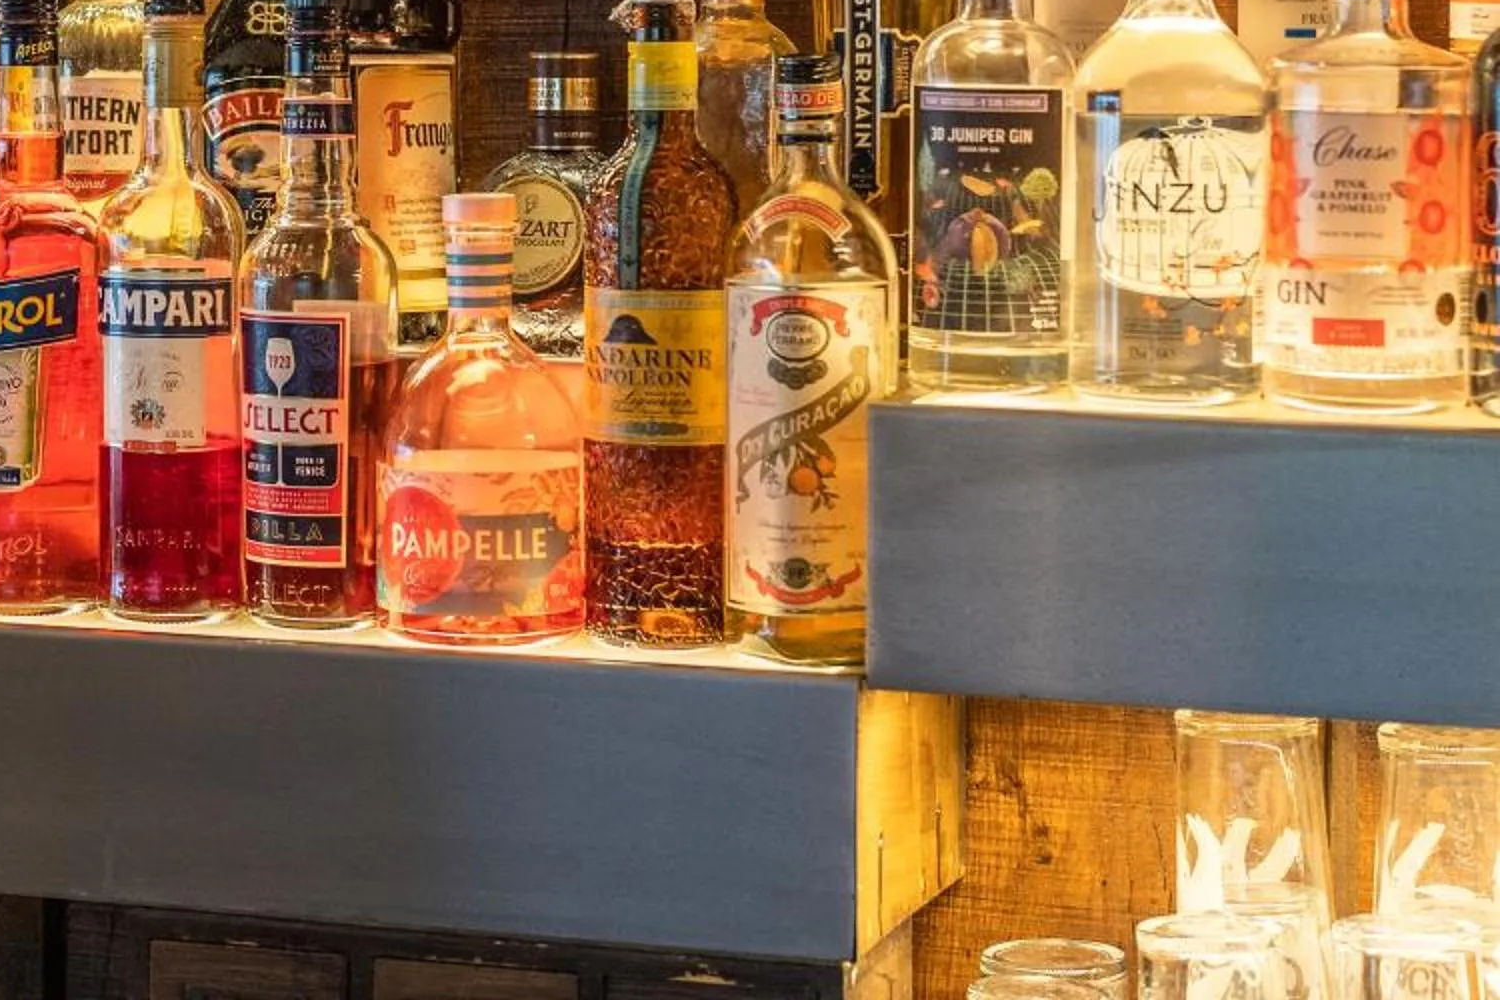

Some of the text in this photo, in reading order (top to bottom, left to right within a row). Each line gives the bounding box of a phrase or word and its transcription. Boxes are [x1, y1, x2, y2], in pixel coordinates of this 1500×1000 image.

[65, 95, 142, 125] THERN
[207, 95, 280, 124] BAIL
[817, 90, 837, 104] DE
[65, 129, 134, 155] MFORT
[383, 101, 451, 157] Frang
[947, 126, 1006, 143] JUNIPER
[1009, 127, 1034, 144] GIN
[1312, 125, 1398, 167] Chase
[1310, 190, 1392, 203] GRAPEFRUIT
[1328, 202, 1387, 214] POMELO
[514, 237, 565, 247] HOCOLATE
[519, 219, 575, 238] ZART
[1277, 278, 1328, 305] GIN
[100, 288, 225, 329] AMPARI
[243, 402, 340, 435] SELECT
[767, 374, 865, 445] CURAÇAO
[294, 465, 326, 477] VENICE
[391, 522, 547, 561] PAMPELLE
